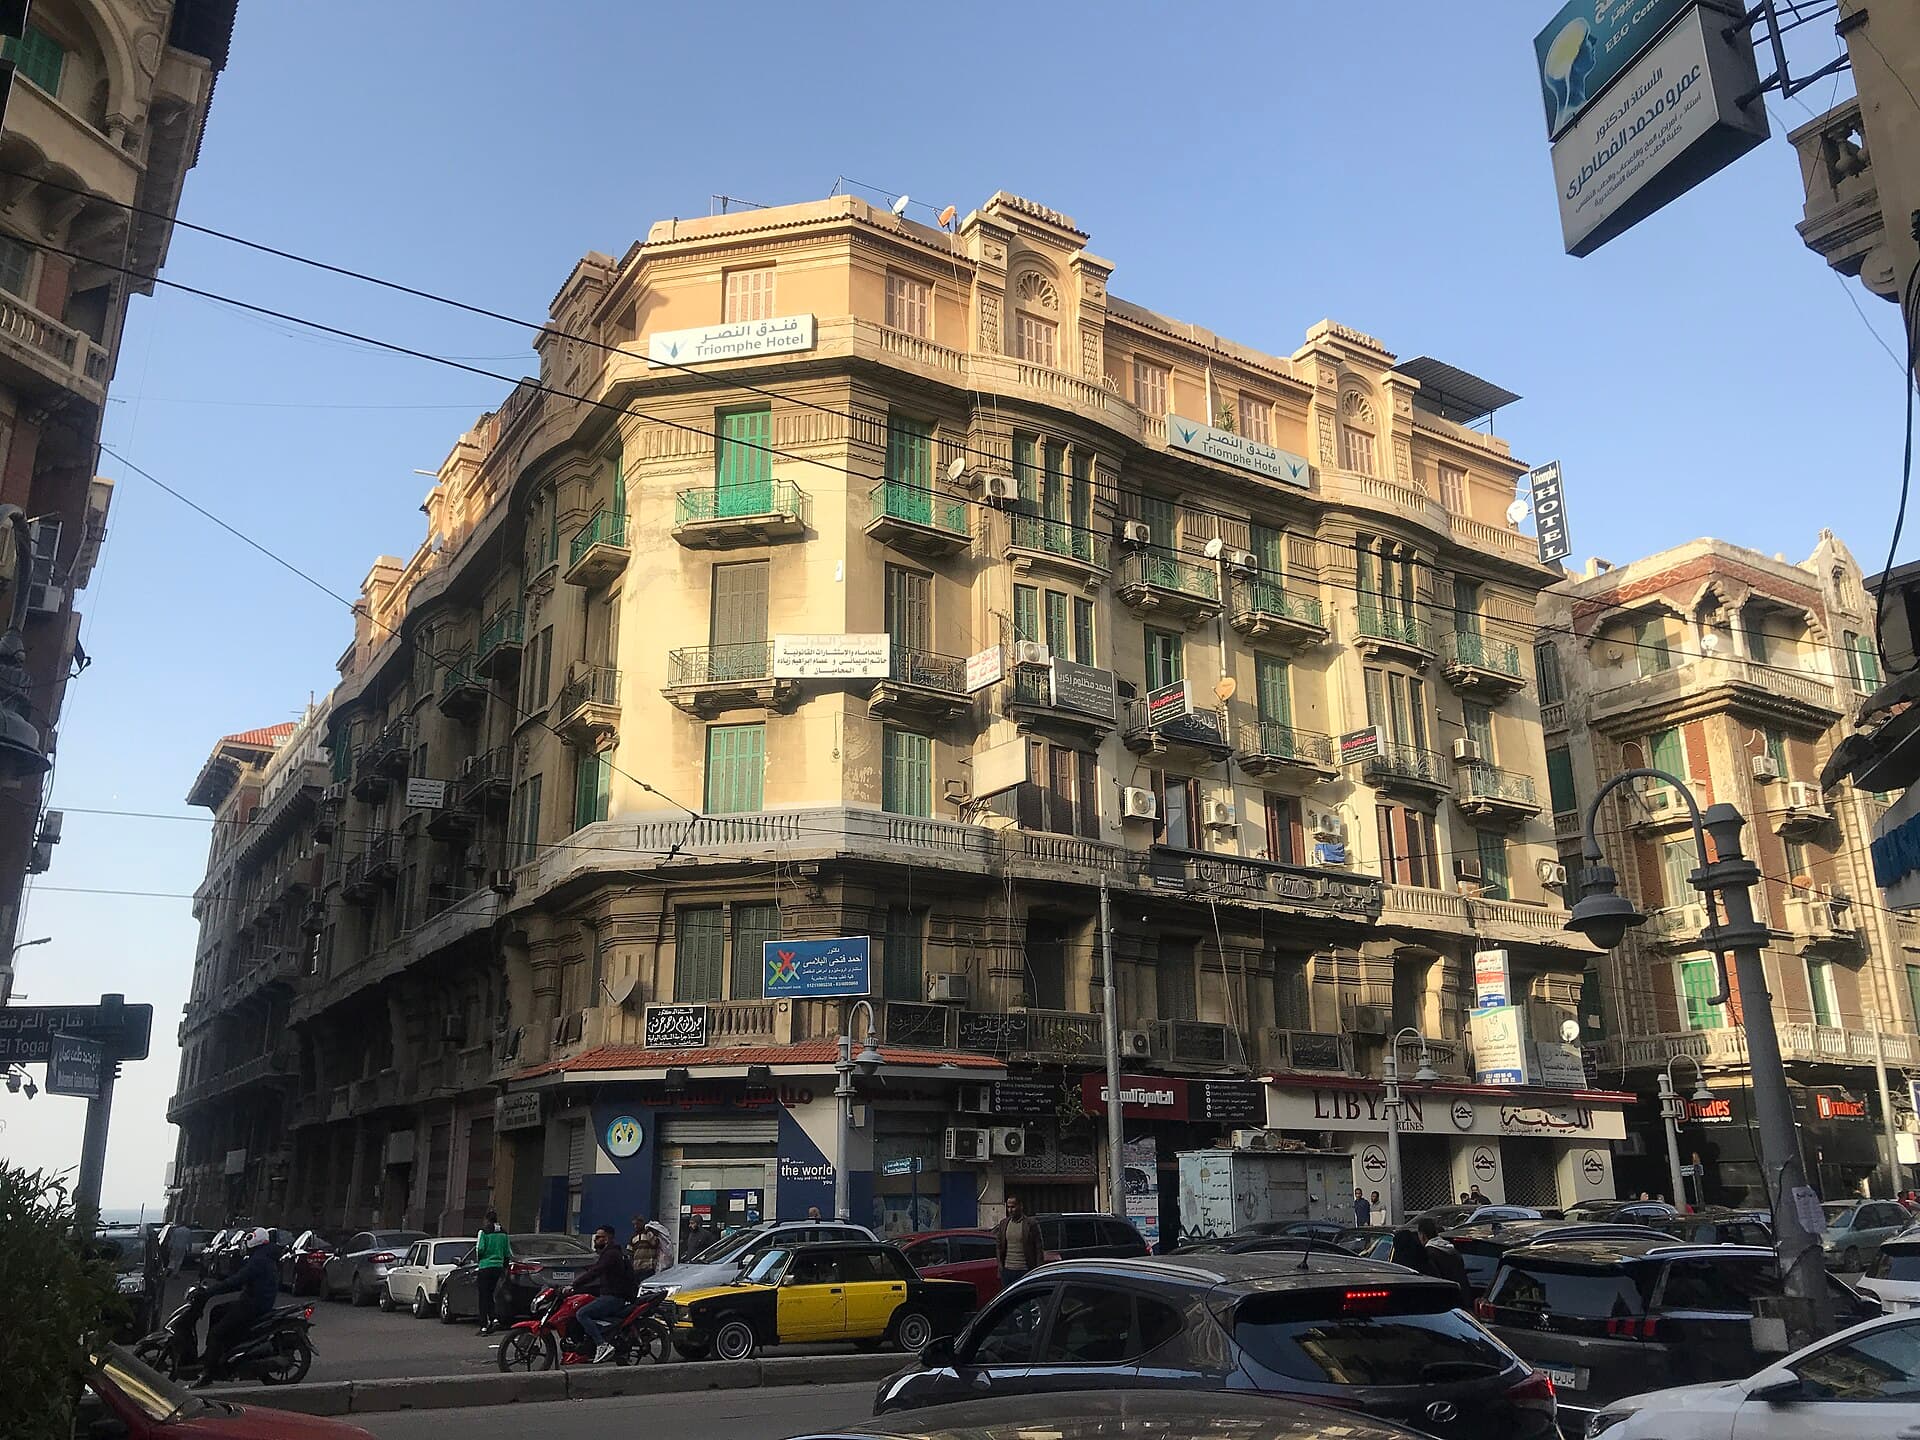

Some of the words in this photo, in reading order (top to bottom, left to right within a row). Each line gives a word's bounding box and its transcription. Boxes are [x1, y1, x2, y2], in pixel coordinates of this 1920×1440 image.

[1605, 23, 1630, 53] EEG
[1666, 64, 1701, 111] عمرو
[1595, 98, 1631, 145] الدكتور
[1628, 98, 1665, 141] محمد
[701, 325, 750, 344] النصر
[756, 318, 798, 337] فندق
[696, 340, 762, 357] Triomphe
[766, 333, 803, 348] Hotel
[1205, 431, 1243, 450] النصر
[1246, 443, 1276, 461] فندق
[1202, 441, 1251, 466] Triomphe
[1254, 457, 1281, 475] Hotel
[1535, 483, 1564, 559] HOTEL
[1190, 857, 1223, 883] TOP
[847, 953, 863, 963] أحمد
[48, 1012, 84, 1034] شارع
[1312, 1089, 1424, 1122] LIBYAN
[1397, 1121, 1425, 1131] RLINES
[781, 1165, 799, 1176] the
[802, 1163, 833, 1176] world
